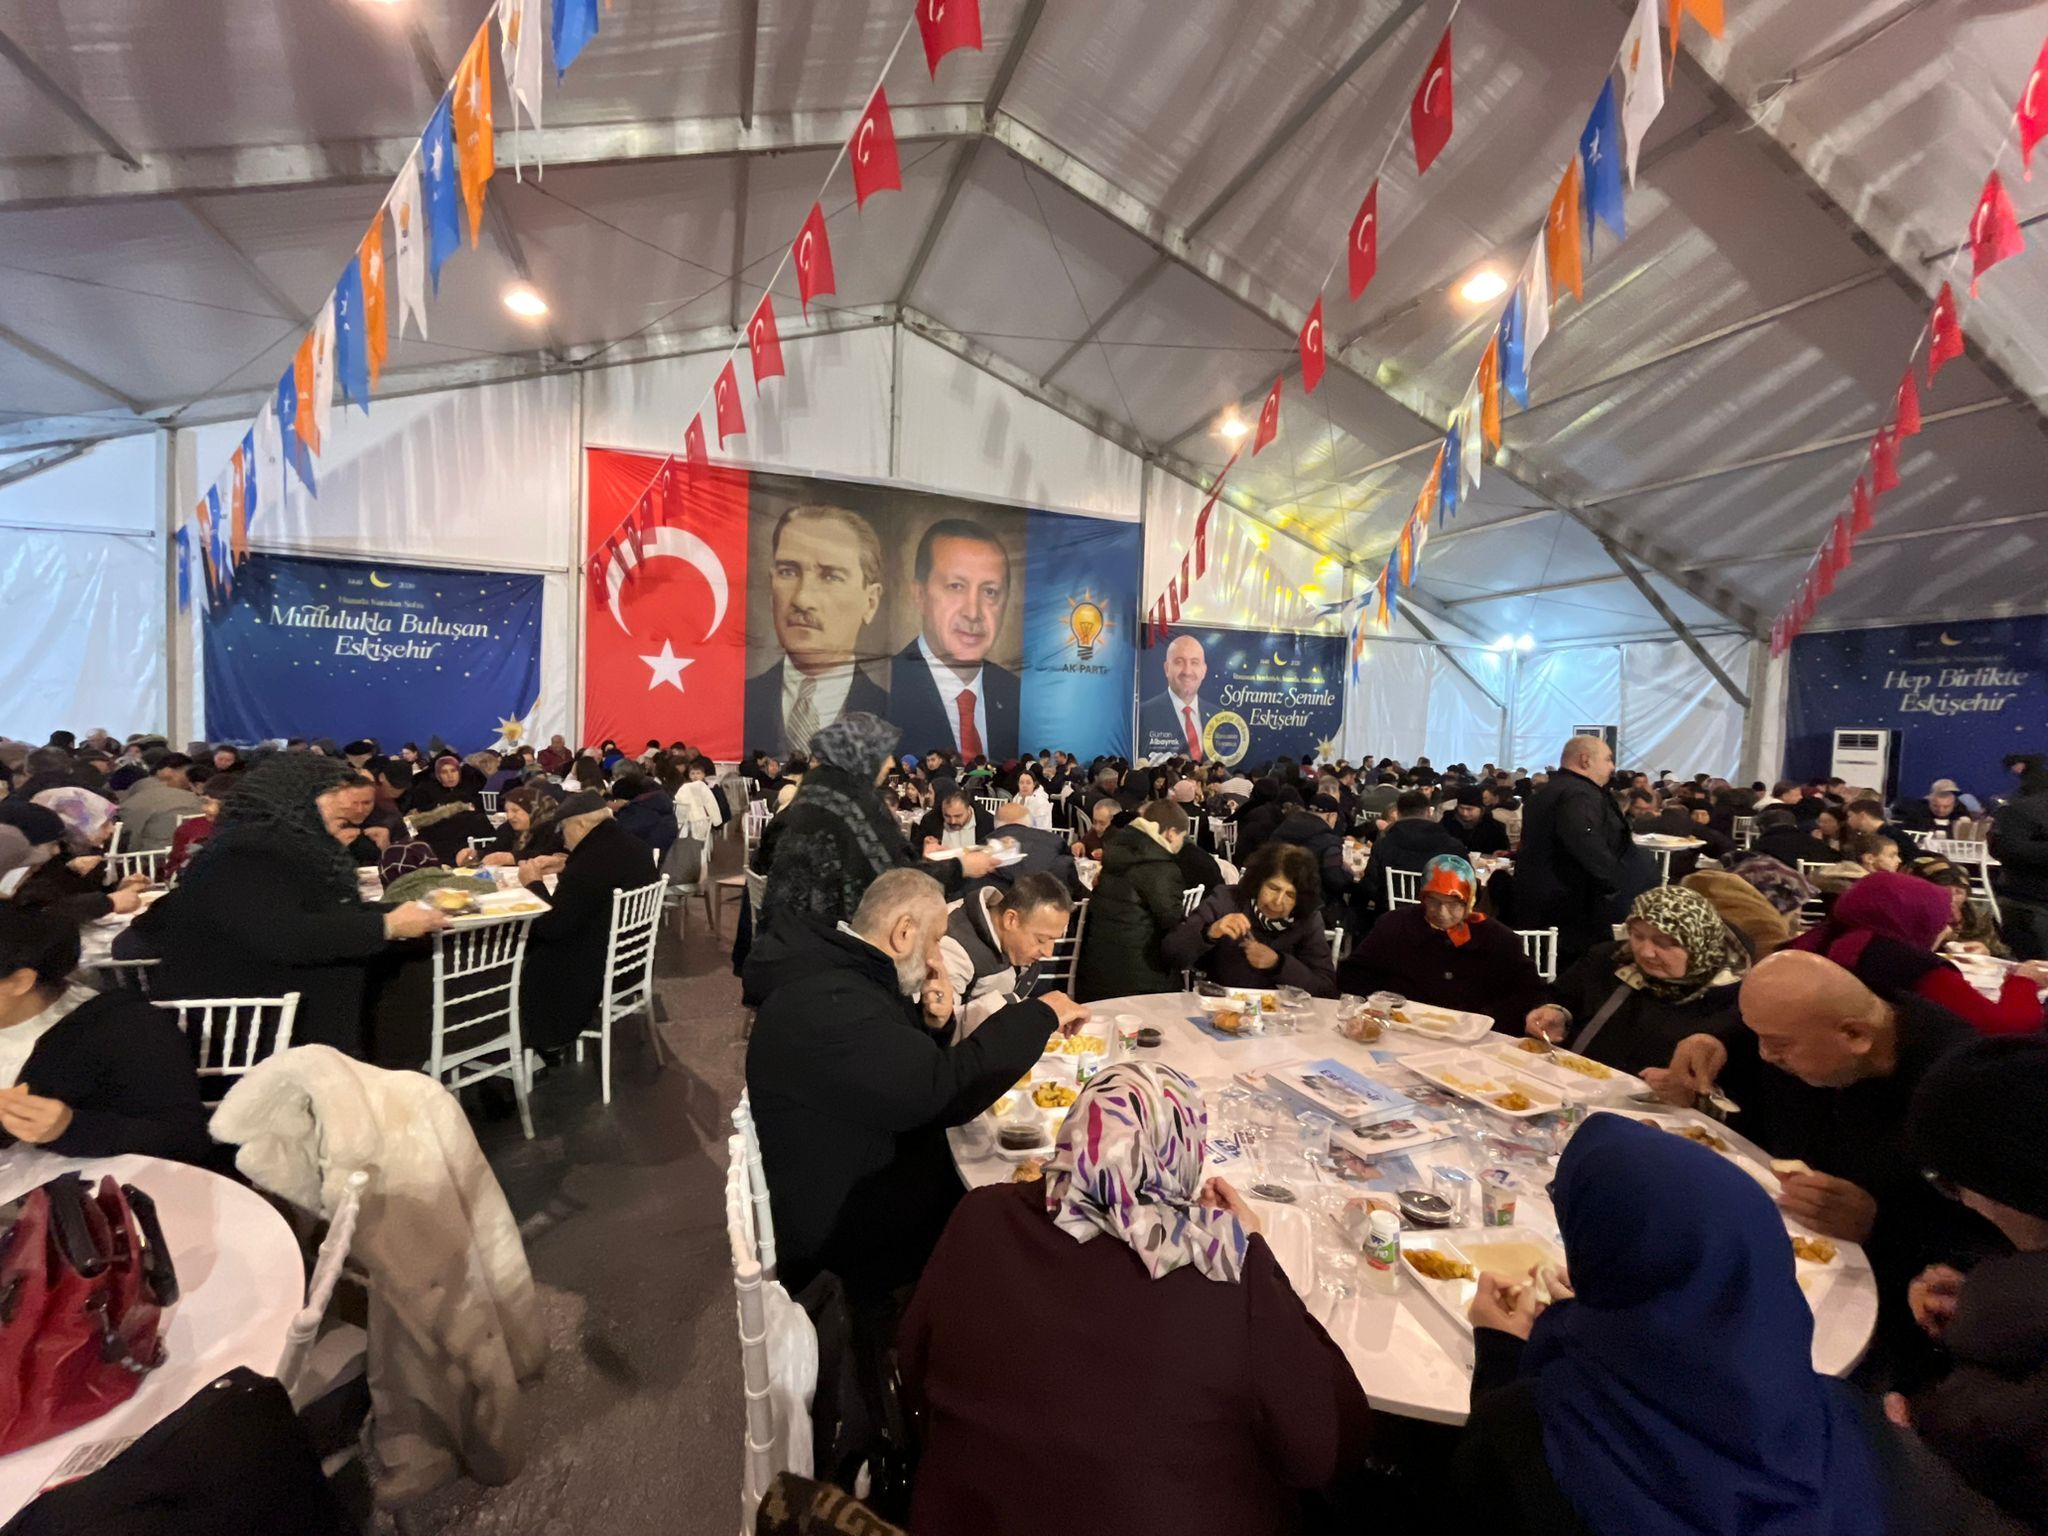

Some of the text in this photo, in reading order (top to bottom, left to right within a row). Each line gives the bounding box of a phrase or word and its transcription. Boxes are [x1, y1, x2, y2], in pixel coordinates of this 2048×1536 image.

[269, 604, 489, 641] Mutlulukla Buluşan
[335, 635, 442, 662] Eskişehir
[1883, 667, 2029, 694] Hep Birlikte
[1220, 684, 1336, 708] Soframız Seninle
[1899, 692, 2017, 716] Eskişehir
[1250, 708, 1314, 730] Eskişehir
[1149, 737, 1180, 747] Albayrak
